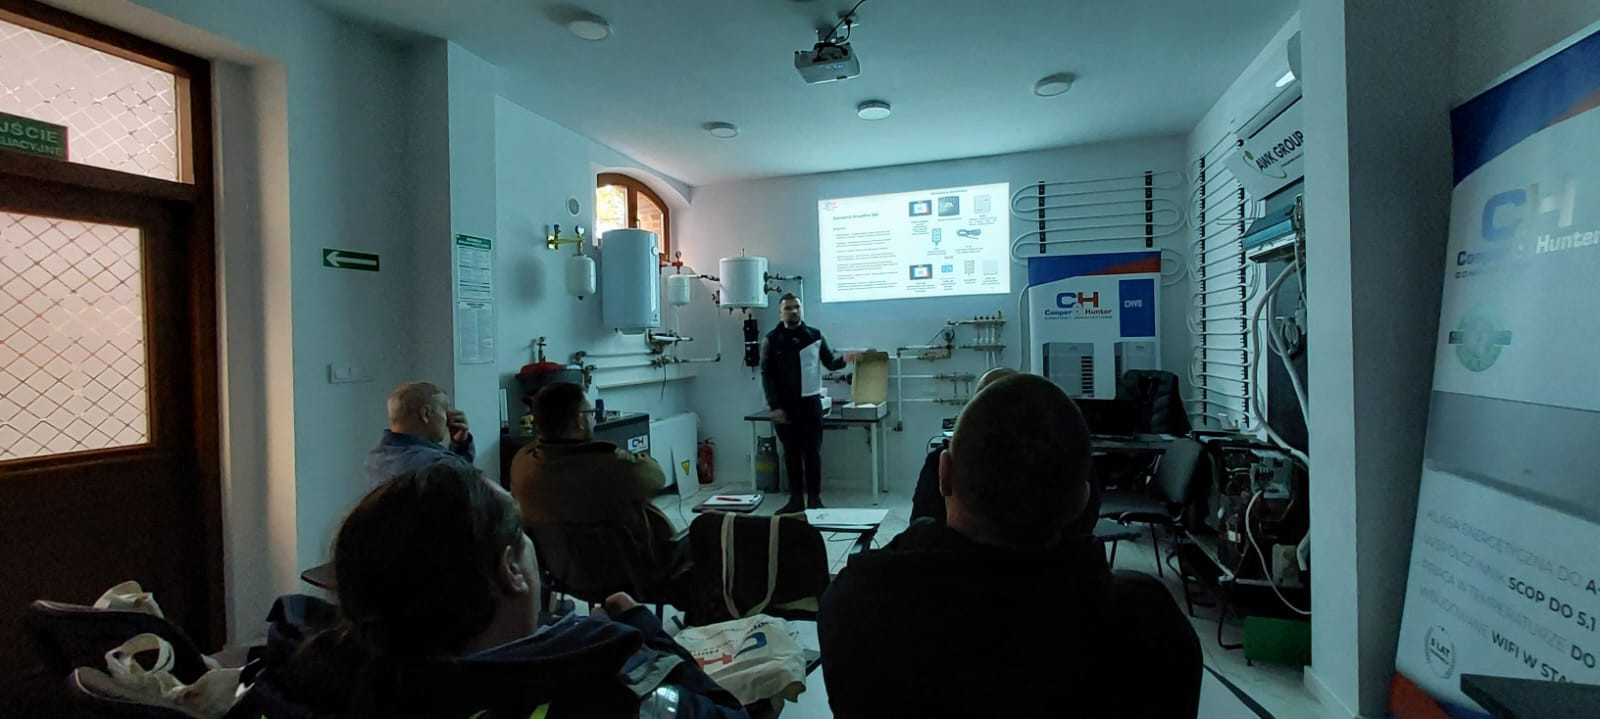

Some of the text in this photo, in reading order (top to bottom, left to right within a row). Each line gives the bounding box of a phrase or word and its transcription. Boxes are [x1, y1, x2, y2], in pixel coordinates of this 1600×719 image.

[0, 136, 63, 156] UACYJNE
[1256, 151, 1278, 171] AWK
[1273, 130, 1304, 158] GROUP
[1056, 291, 1099, 308] CH
[1557, 565, 1582, 587] DO
[1508, 576, 1545, 603] SCOP
[1549, 597, 1573, 619] DO
[1576, 611, 1597, 632] 5.1
[1490, 629, 1520, 659] WIFI
[1522, 650, 1538, 669] W
[1540, 662, 1575, 683] STA
[1570, 644, 1596, 669] DO
